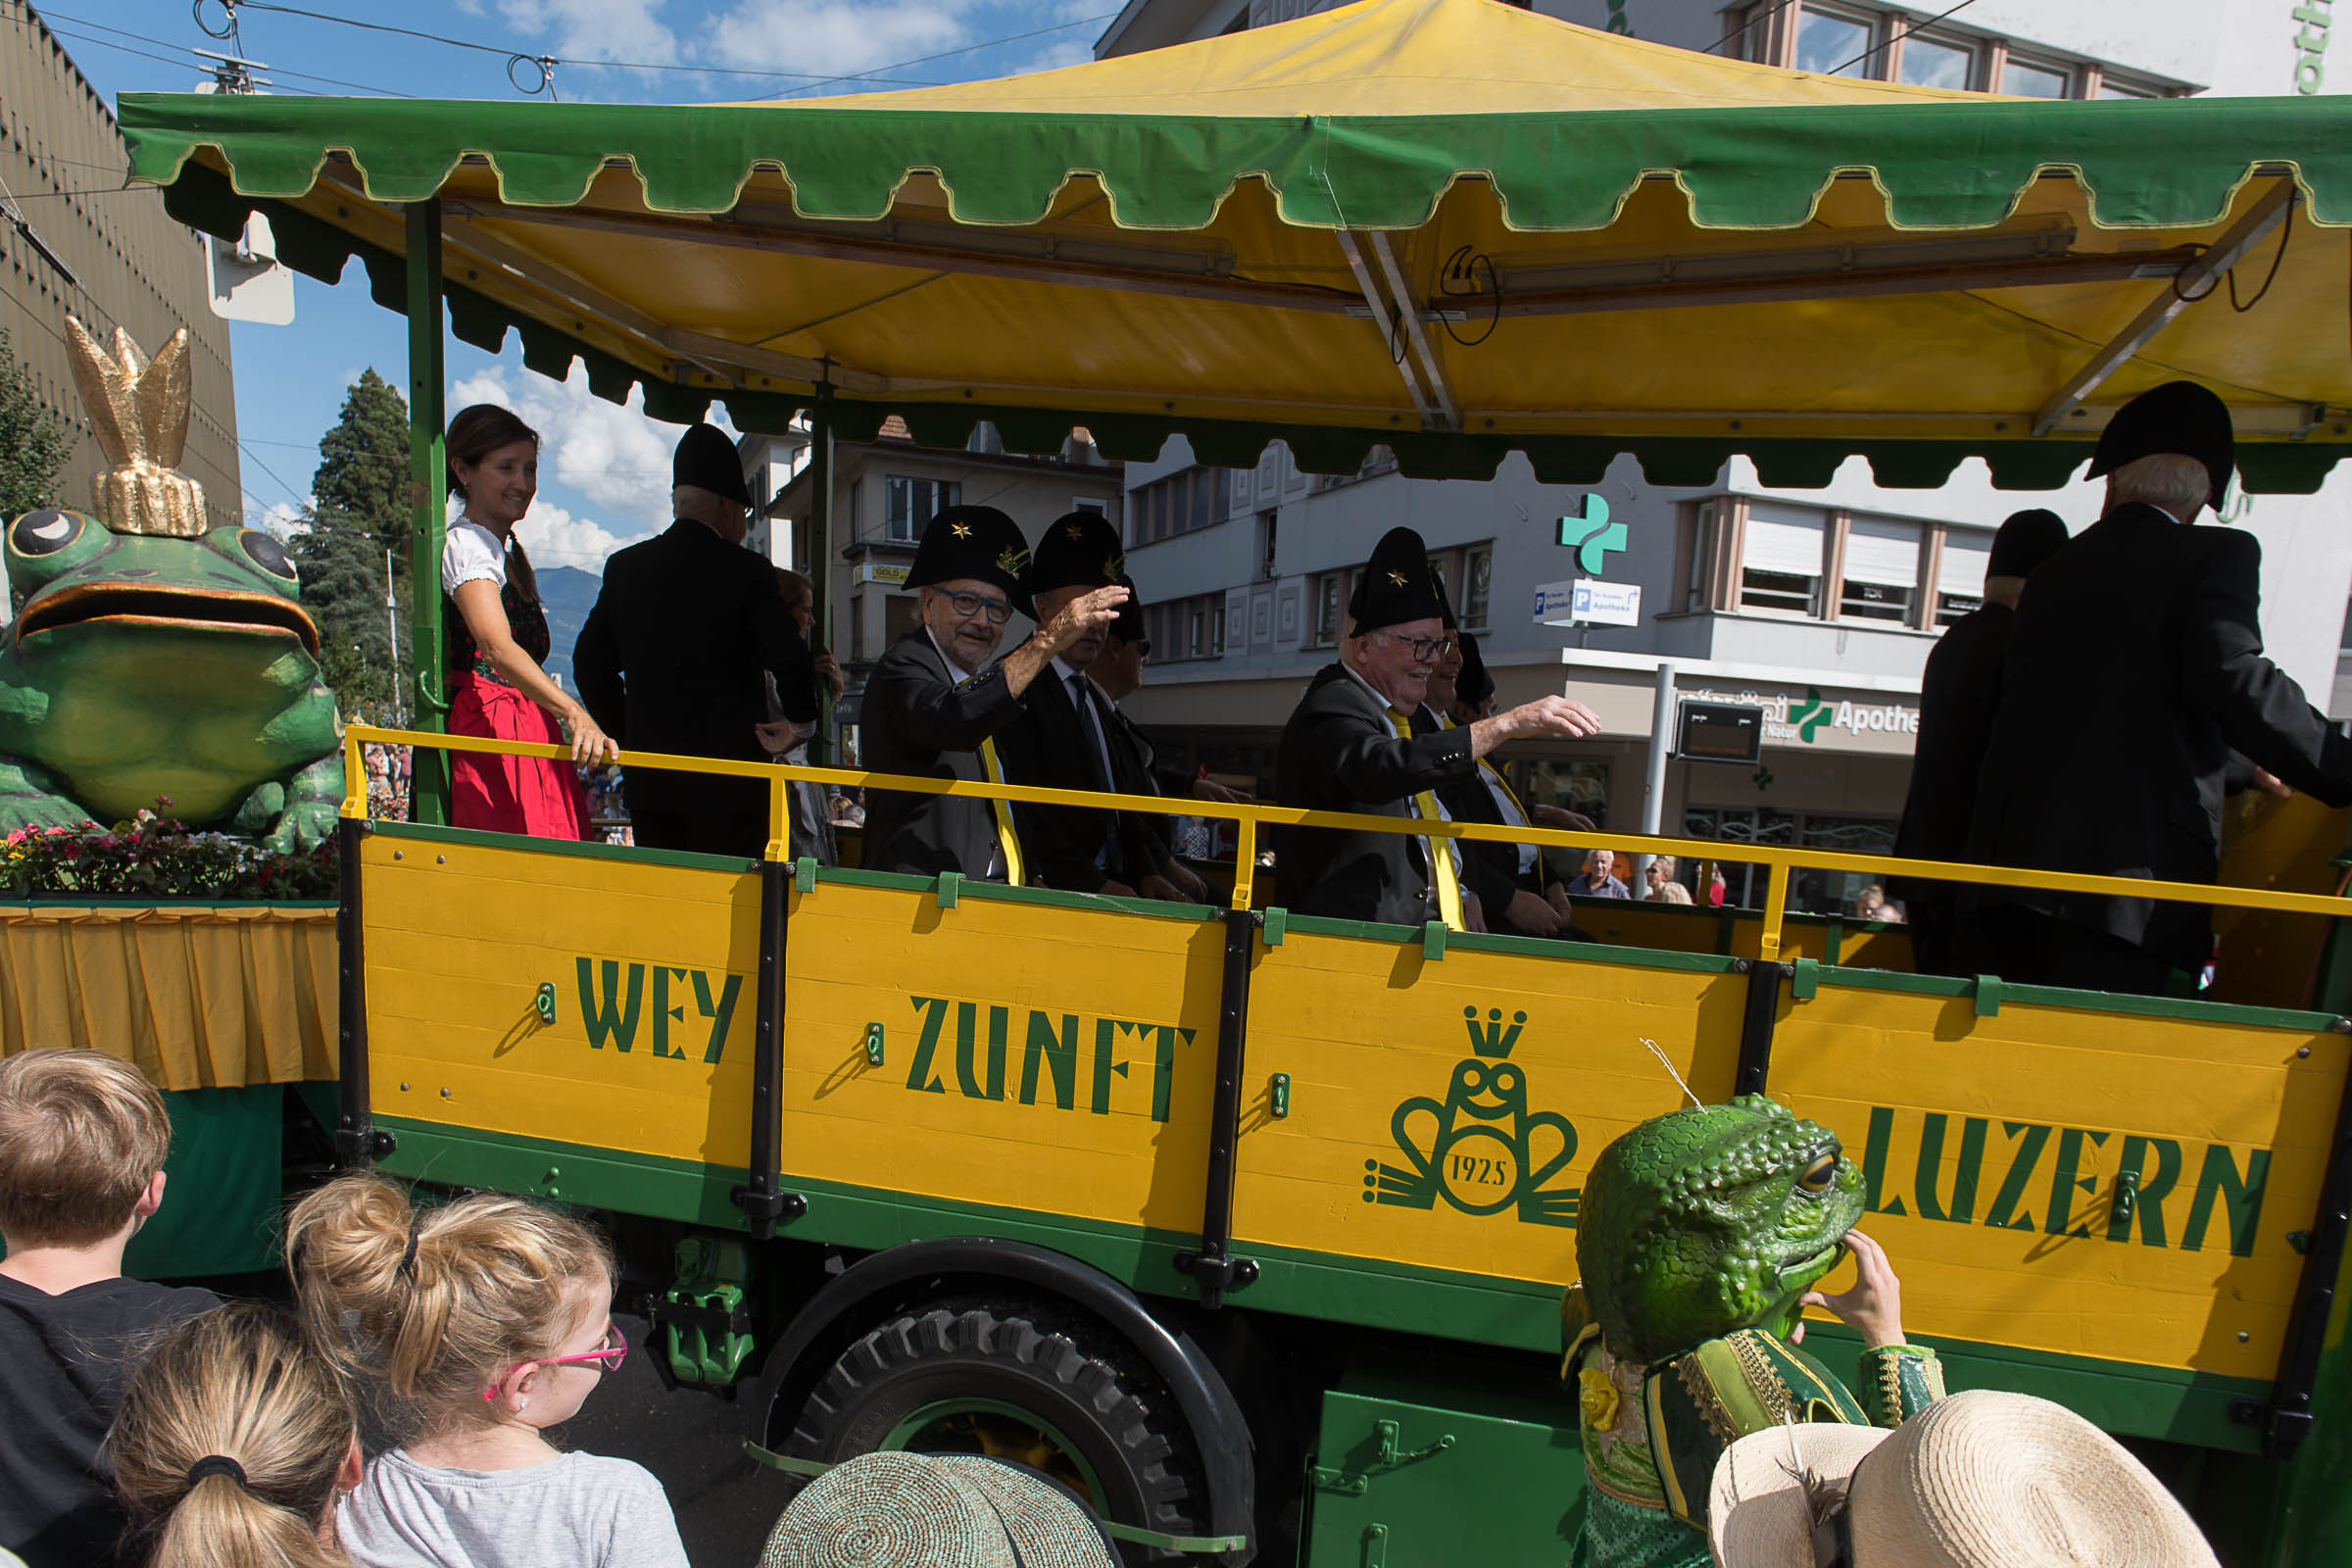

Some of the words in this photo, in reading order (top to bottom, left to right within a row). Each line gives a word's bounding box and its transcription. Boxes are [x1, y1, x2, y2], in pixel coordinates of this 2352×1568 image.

[575, 956, 743, 1064] WEY
[905, 996, 1197, 1123] ZUNFT
[1863, 1105, 2273, 1258] LUZERN
[1452, 1154, 1507, 1186] 1925
